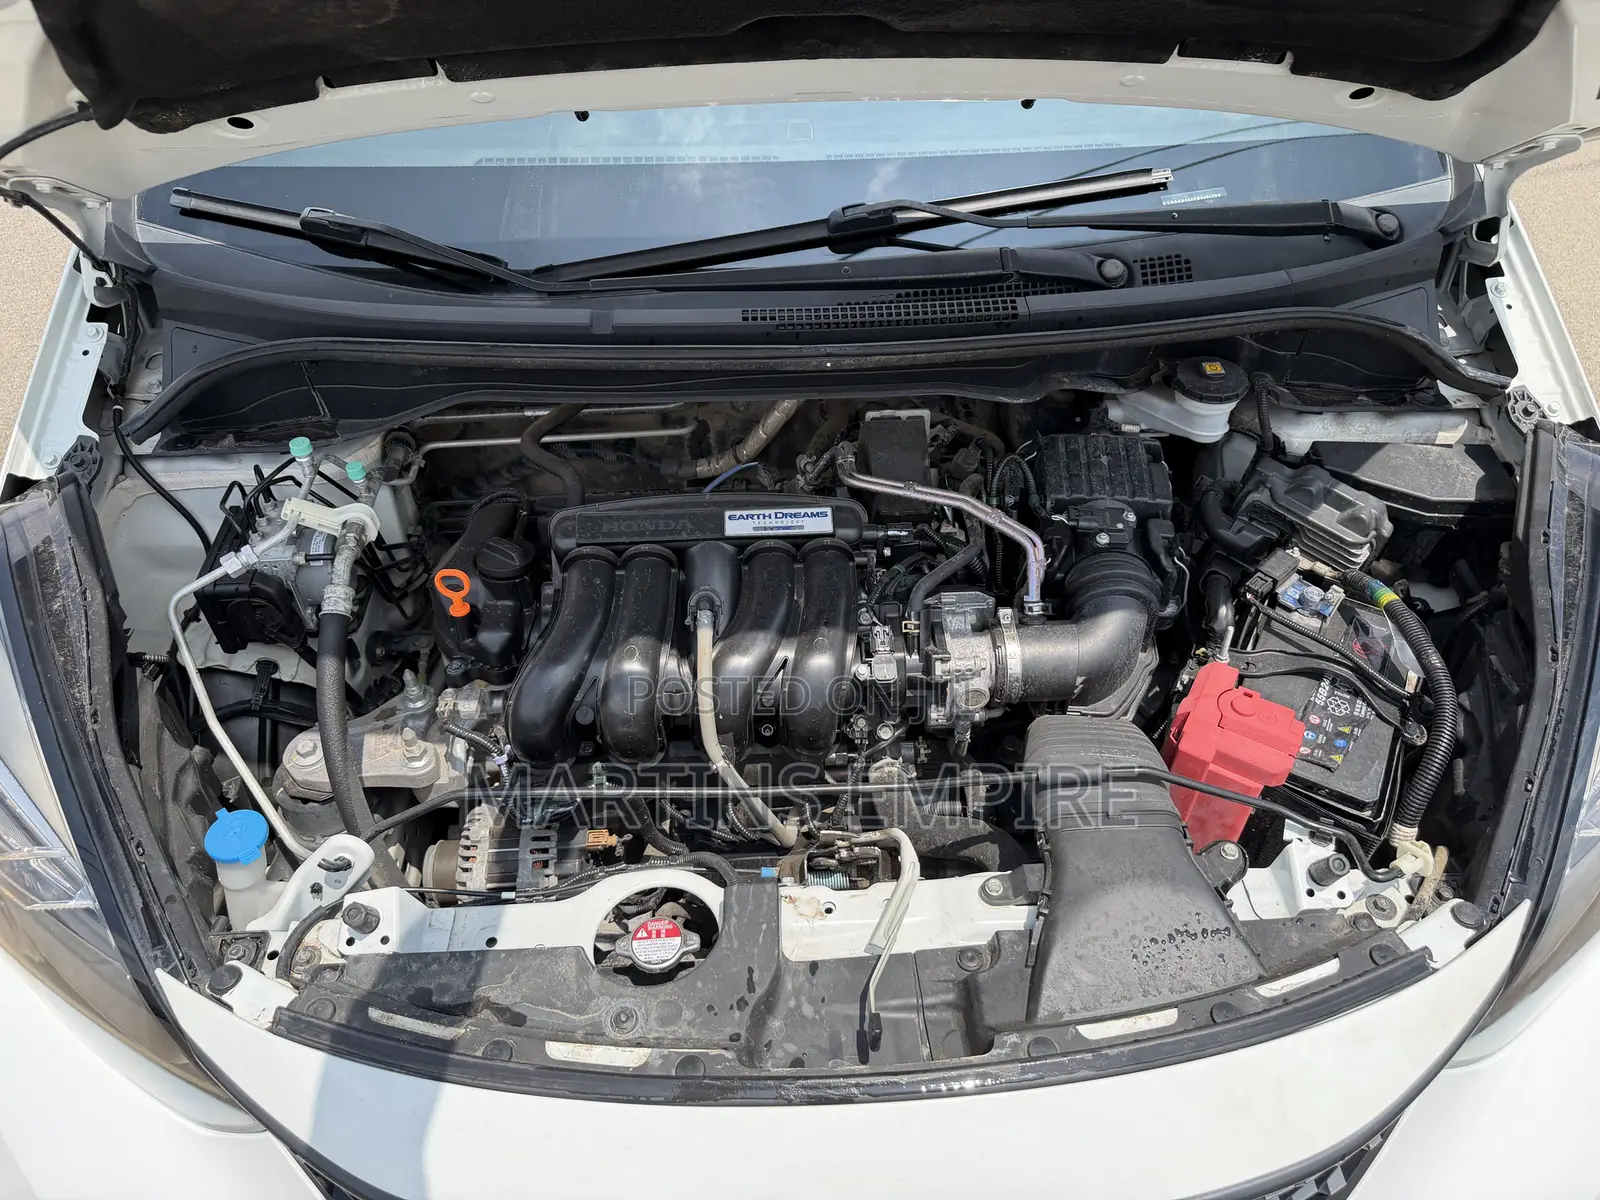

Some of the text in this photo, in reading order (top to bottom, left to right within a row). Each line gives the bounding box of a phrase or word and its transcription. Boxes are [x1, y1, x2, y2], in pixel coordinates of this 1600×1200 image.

[728, 511, 828, 521] EARTH DREAMS
[601, 519, 694, 533] HONDA
